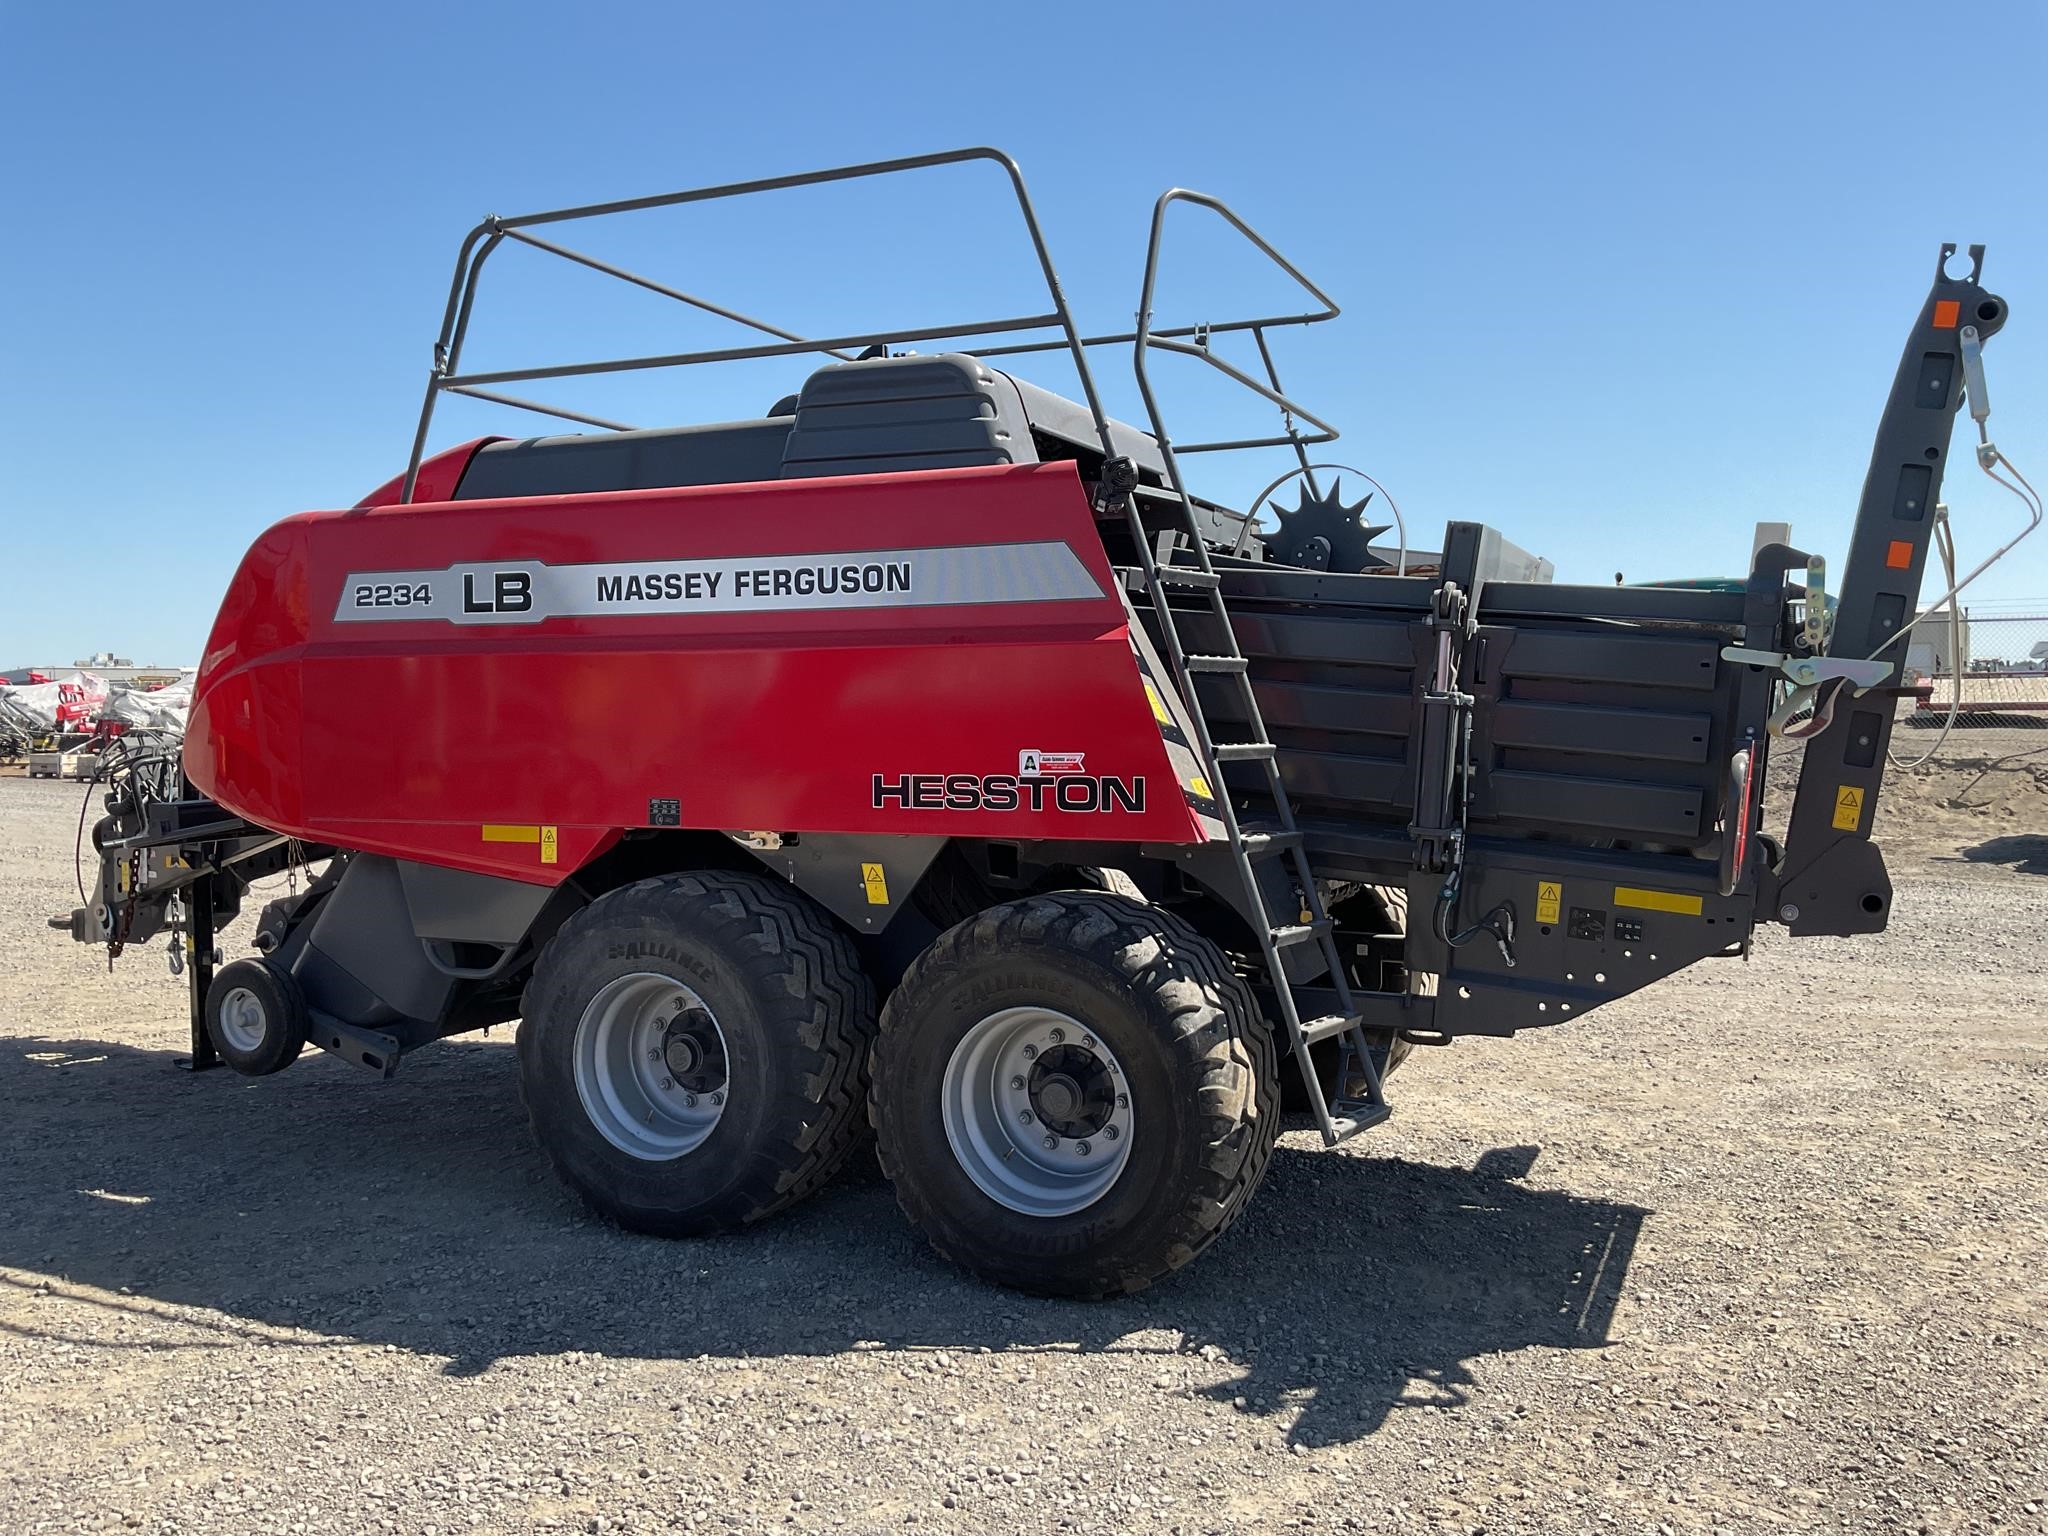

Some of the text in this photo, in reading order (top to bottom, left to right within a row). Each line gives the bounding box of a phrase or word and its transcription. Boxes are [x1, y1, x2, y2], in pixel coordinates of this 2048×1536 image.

[355, 583, 432, 608] 2234
[463, 572, 533, 614] LB
[596, 562, 911, 602] MASSEY FERGUSON
[872, 774, 1146, 813] HESSTON
[625, 941, 713, 983] ALLIANCE
